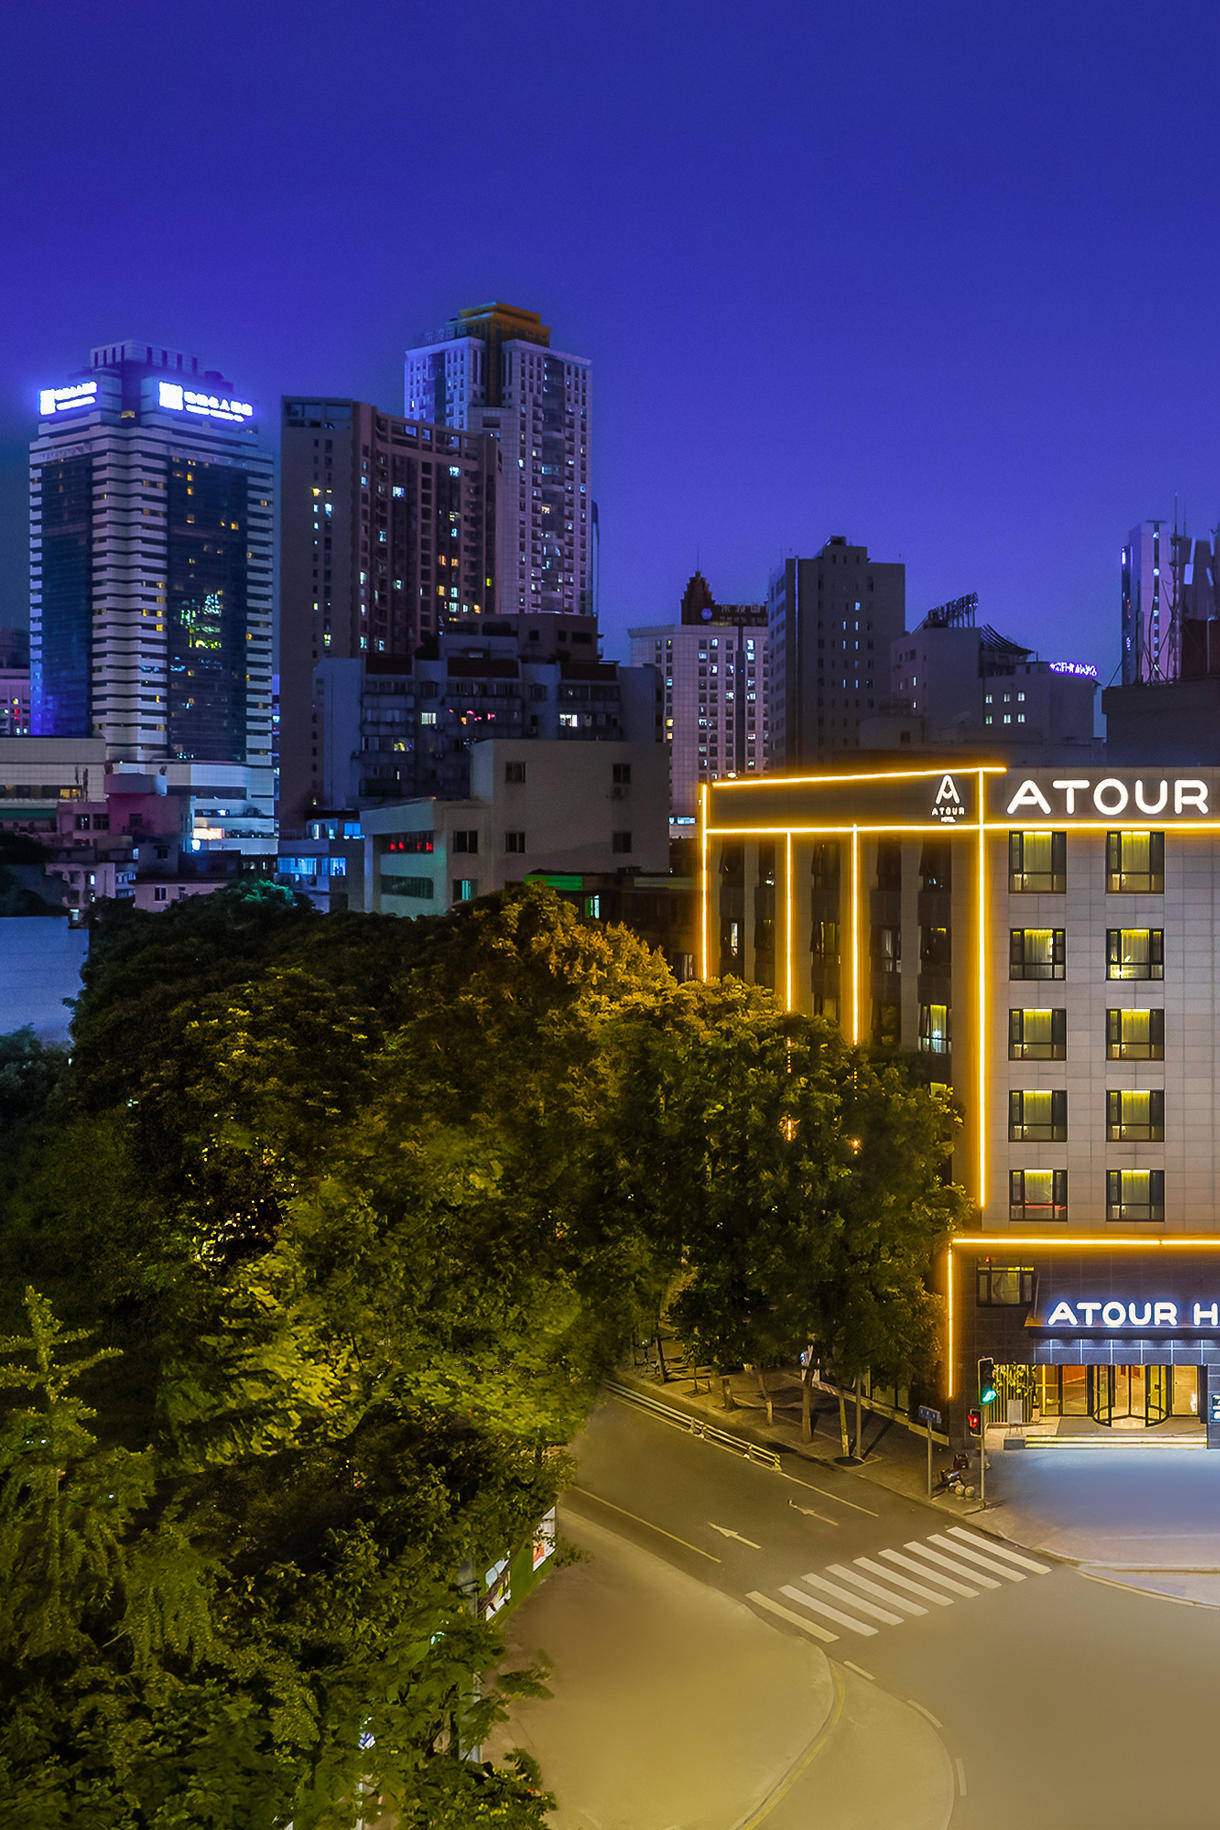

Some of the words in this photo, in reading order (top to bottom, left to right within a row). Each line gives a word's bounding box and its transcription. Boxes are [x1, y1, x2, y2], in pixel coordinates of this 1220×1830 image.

[1007, 778, 1209, 815] ATOUR
[932, 807, 965, 816] ATOUR
[1048, 1301, 1178, 1326] ATOUR
